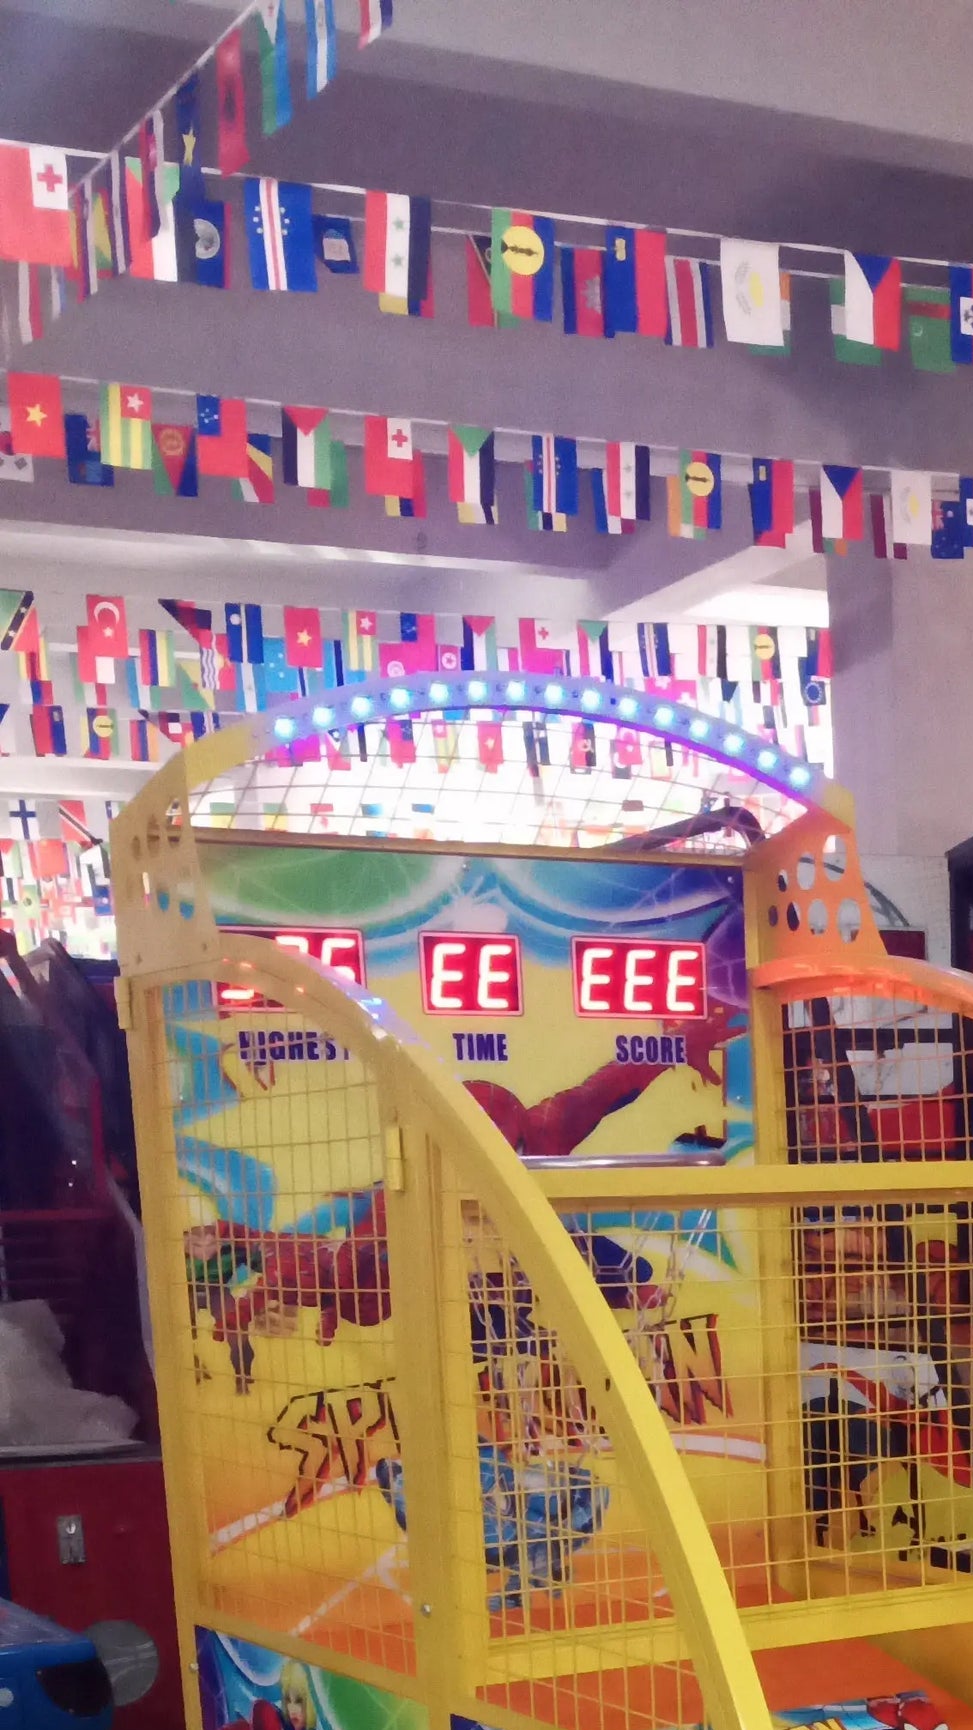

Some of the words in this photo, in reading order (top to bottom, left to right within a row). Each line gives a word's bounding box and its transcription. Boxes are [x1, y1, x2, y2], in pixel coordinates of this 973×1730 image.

[238, 1030, 350, 1061] HIGHES
[452, 1032, 509, 1062] TIME
[615, 1034, 686, 1064] SCORE
